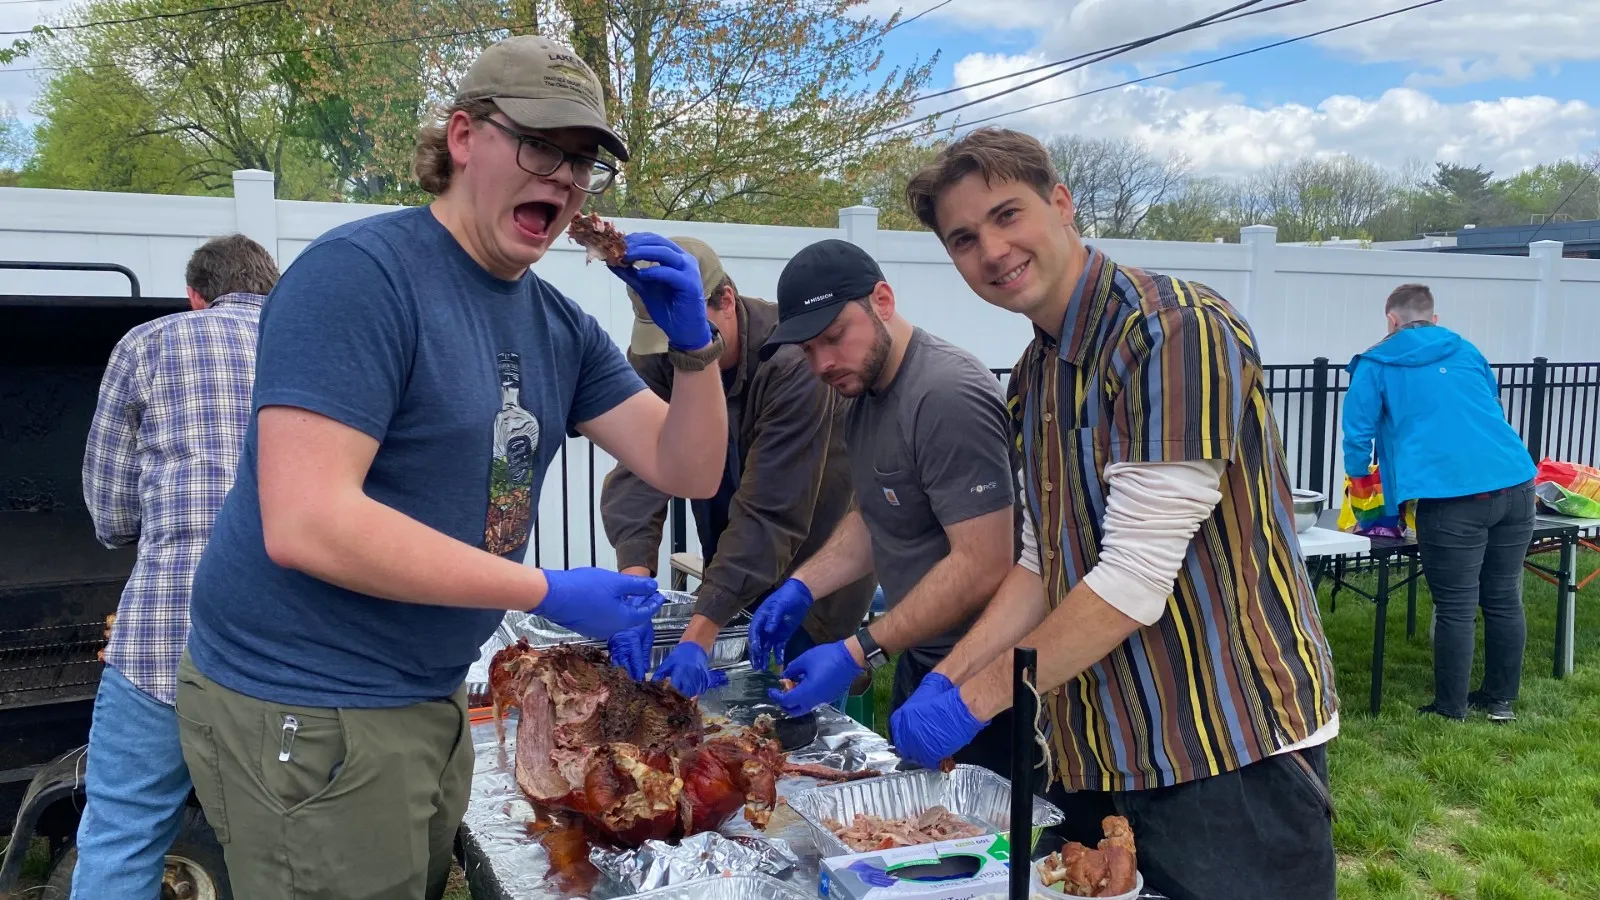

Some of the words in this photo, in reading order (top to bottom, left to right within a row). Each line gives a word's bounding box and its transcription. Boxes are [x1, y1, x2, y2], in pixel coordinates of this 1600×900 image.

[548, 54, 573, 62] LAKE
[810, 293, 833, 303] MISSION
[970, 481, 997, 493] FORCE
